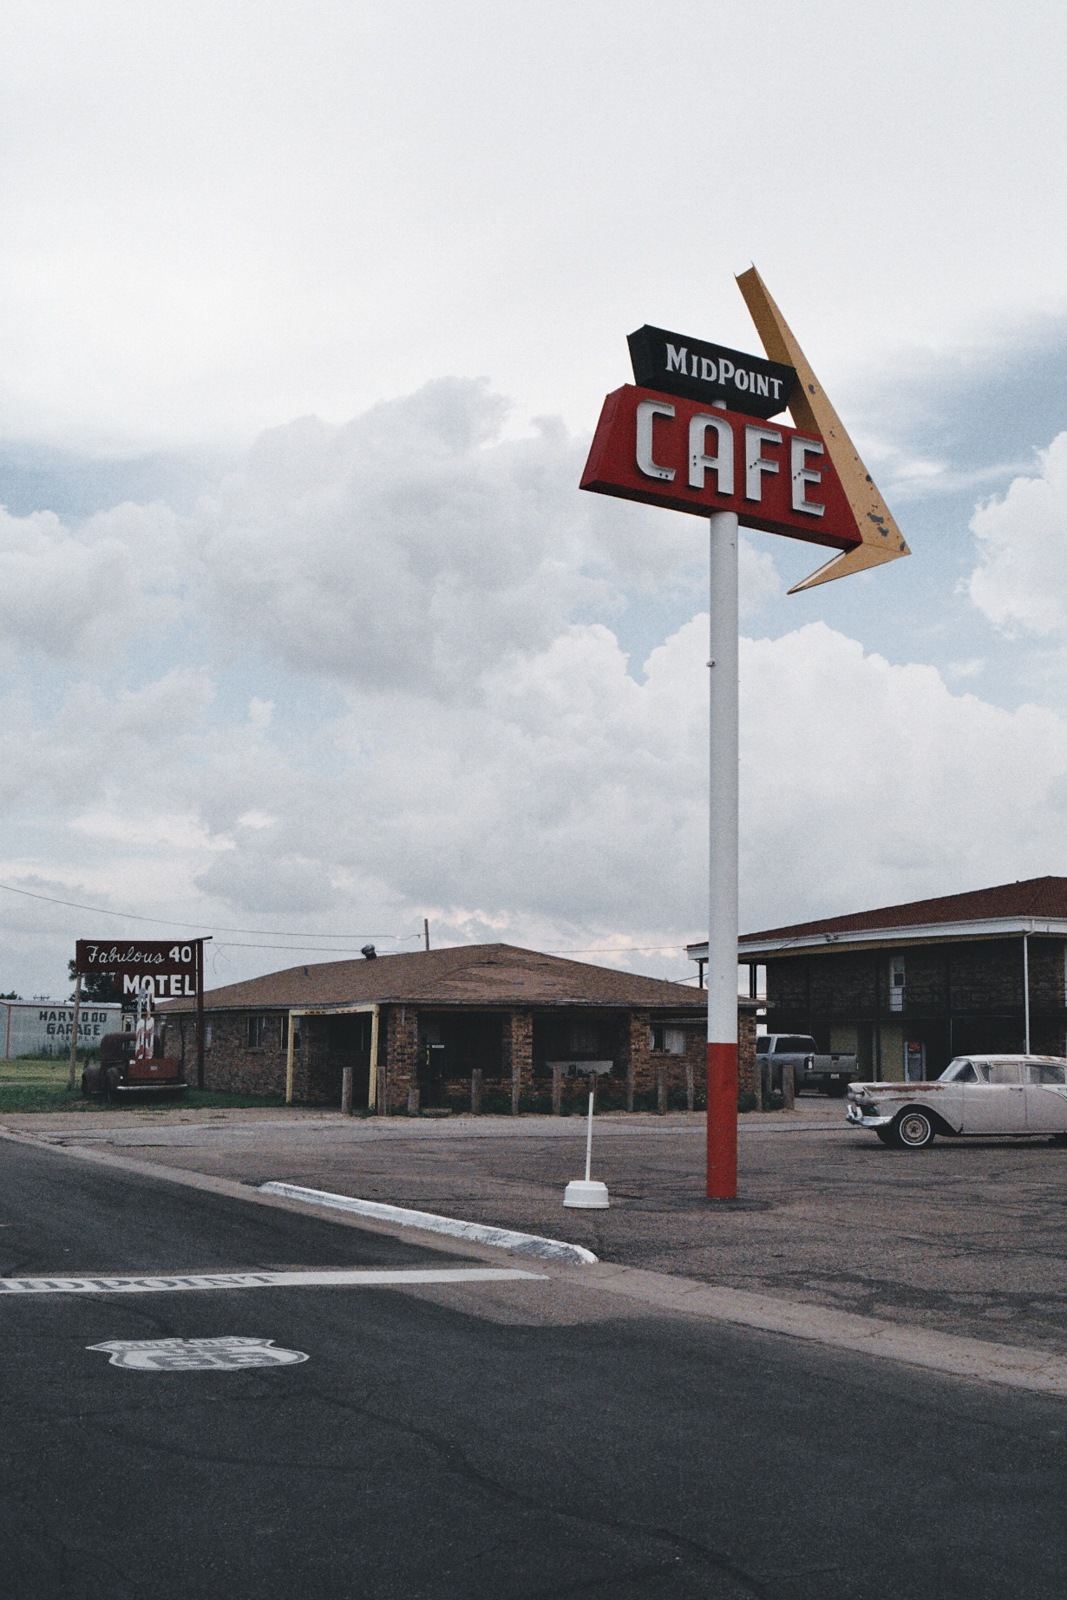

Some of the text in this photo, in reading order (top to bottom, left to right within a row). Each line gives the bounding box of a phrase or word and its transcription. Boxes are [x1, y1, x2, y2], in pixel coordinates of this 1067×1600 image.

[636, 399, 825, 516] CAFE
[86, 945, 192, 964] Fabulous 40
[123, 974, 196, 996] MOTEL
[46, 1023, 101, 1035] GARAGE
